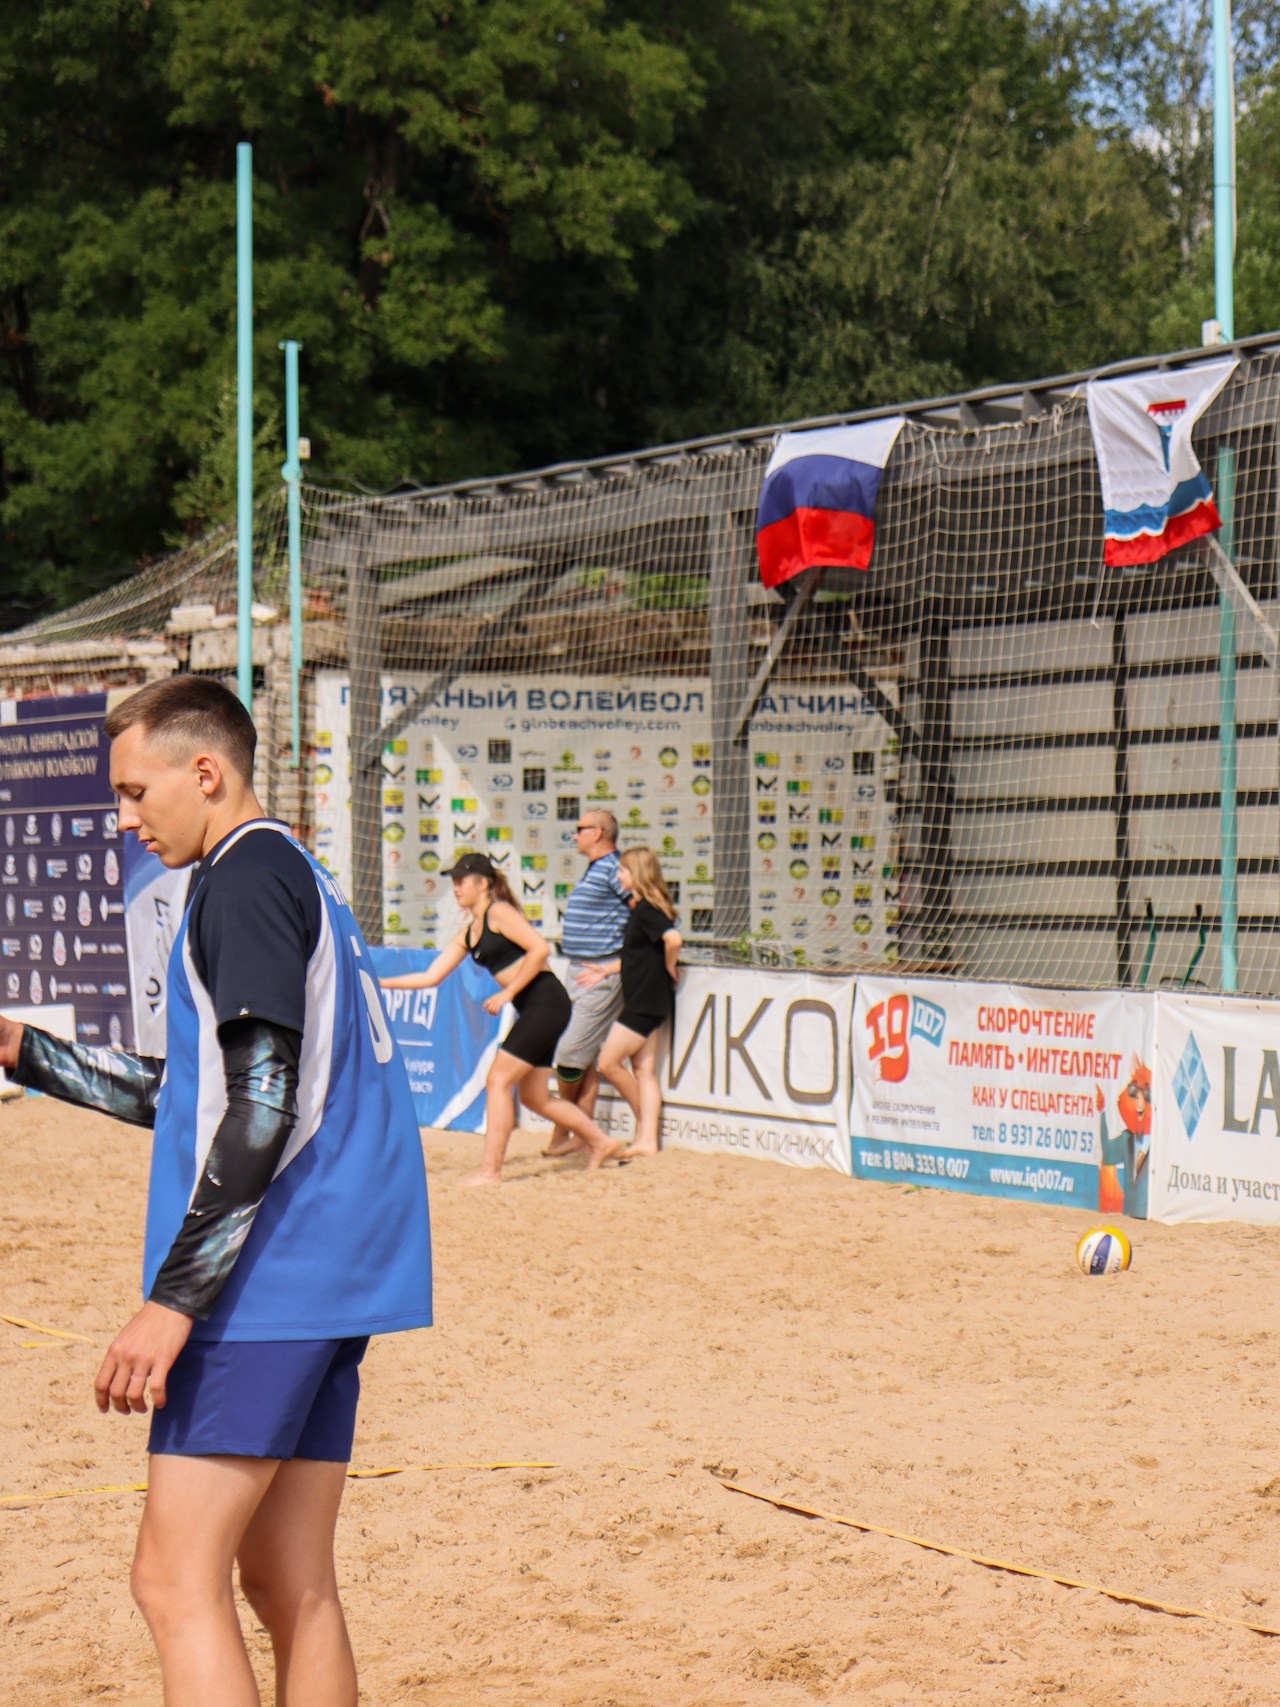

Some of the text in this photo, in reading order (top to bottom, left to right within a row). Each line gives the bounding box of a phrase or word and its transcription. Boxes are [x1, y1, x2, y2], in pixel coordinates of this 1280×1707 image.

[527, 684, 704, 713] ВОЛЕЙБОЛ
[914, 1001, 945, 1038] 007
[978, 1006, 1096, 1040] СКОРОЧТЕНИЕ
[668, 993, 839, 1106] ИКО
[949, 1040, 1123, 1081] ПАМЯТЬ ИНТЕЛЛЕКТ
[972, 1085, 1095, 1117] КАК У СПЕЦАГЕНТА
[660, 1117, 750, 1148] ЕРИНАРНЫЕ
[756, 1129, 835, 1159] КЛИНИКИ
[998, 1123, 1007, 1144] 8
[1011, 1124, 1033, 1147] 931
[1036, 1126, 1052, 1148] 26
[1055, 1128, 1078, 1152] 007
[1080, 1131, 1094, 1154] 53
[883, 1149, 892, 1170] 8
[915, 1153, 937, 1175] 333
[937, 1155, 946, 1177] 8
[946, 1157, 970, 1179] 007
[989, 1165, 1075, 1193] www.iq007.ru
[1167, 1164, 1213, 1194] Дома
[1217, 1176, 1228, 1194] и
